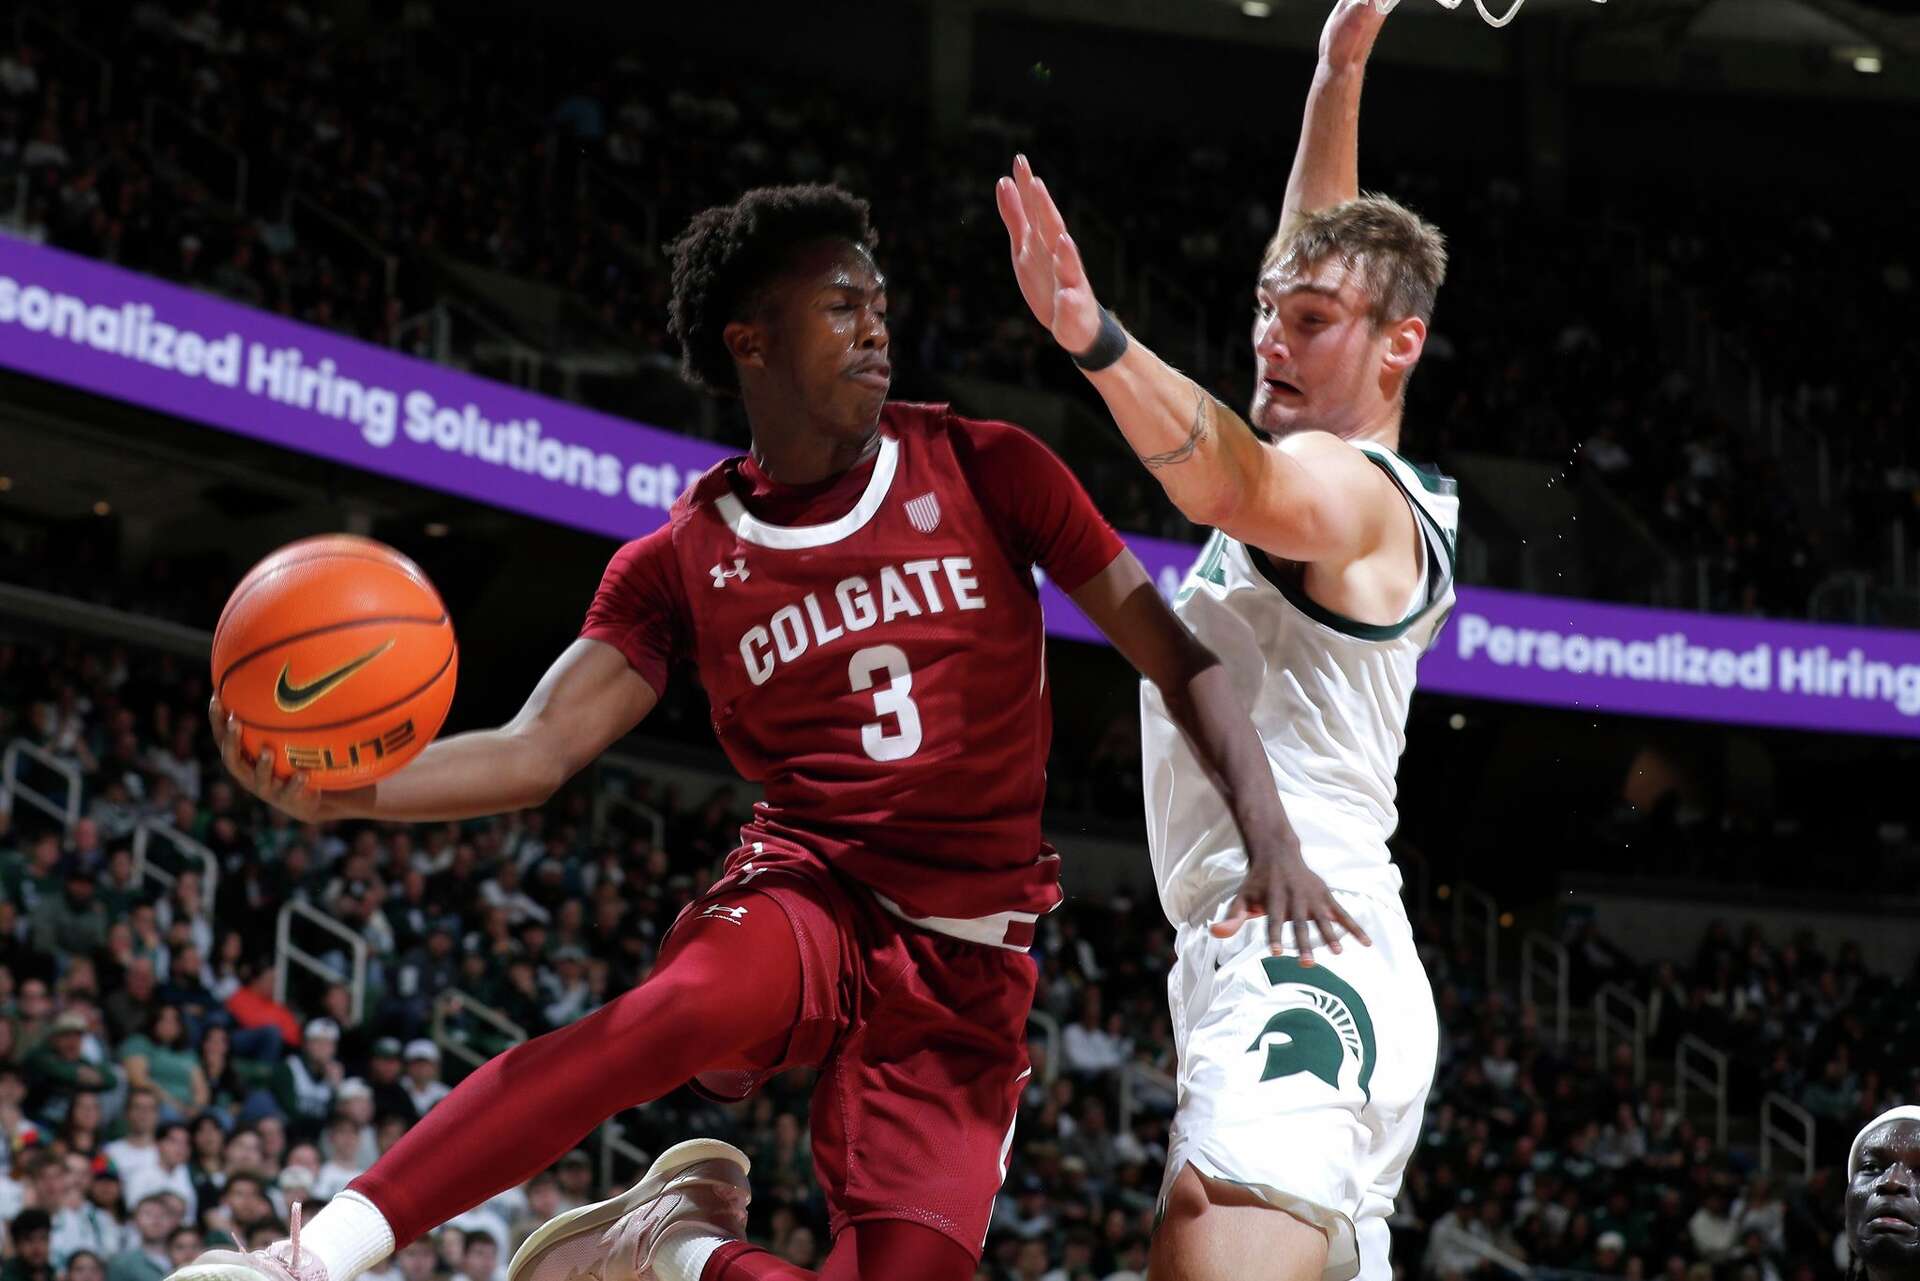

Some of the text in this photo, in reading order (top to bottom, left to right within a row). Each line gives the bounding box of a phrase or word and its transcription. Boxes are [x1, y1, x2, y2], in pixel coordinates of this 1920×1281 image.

[247, 343, 398, 446] Hiring
[404, 391, 622, 496] Solutions
[626, 463, 680, 512] at
[739, 557, 985, 686] COLGATE
[1458, 614, 1920, 715] Personalized Hiring
[285, 719, 416, 769] ELITE
[848, 644, 922, 762] 3
